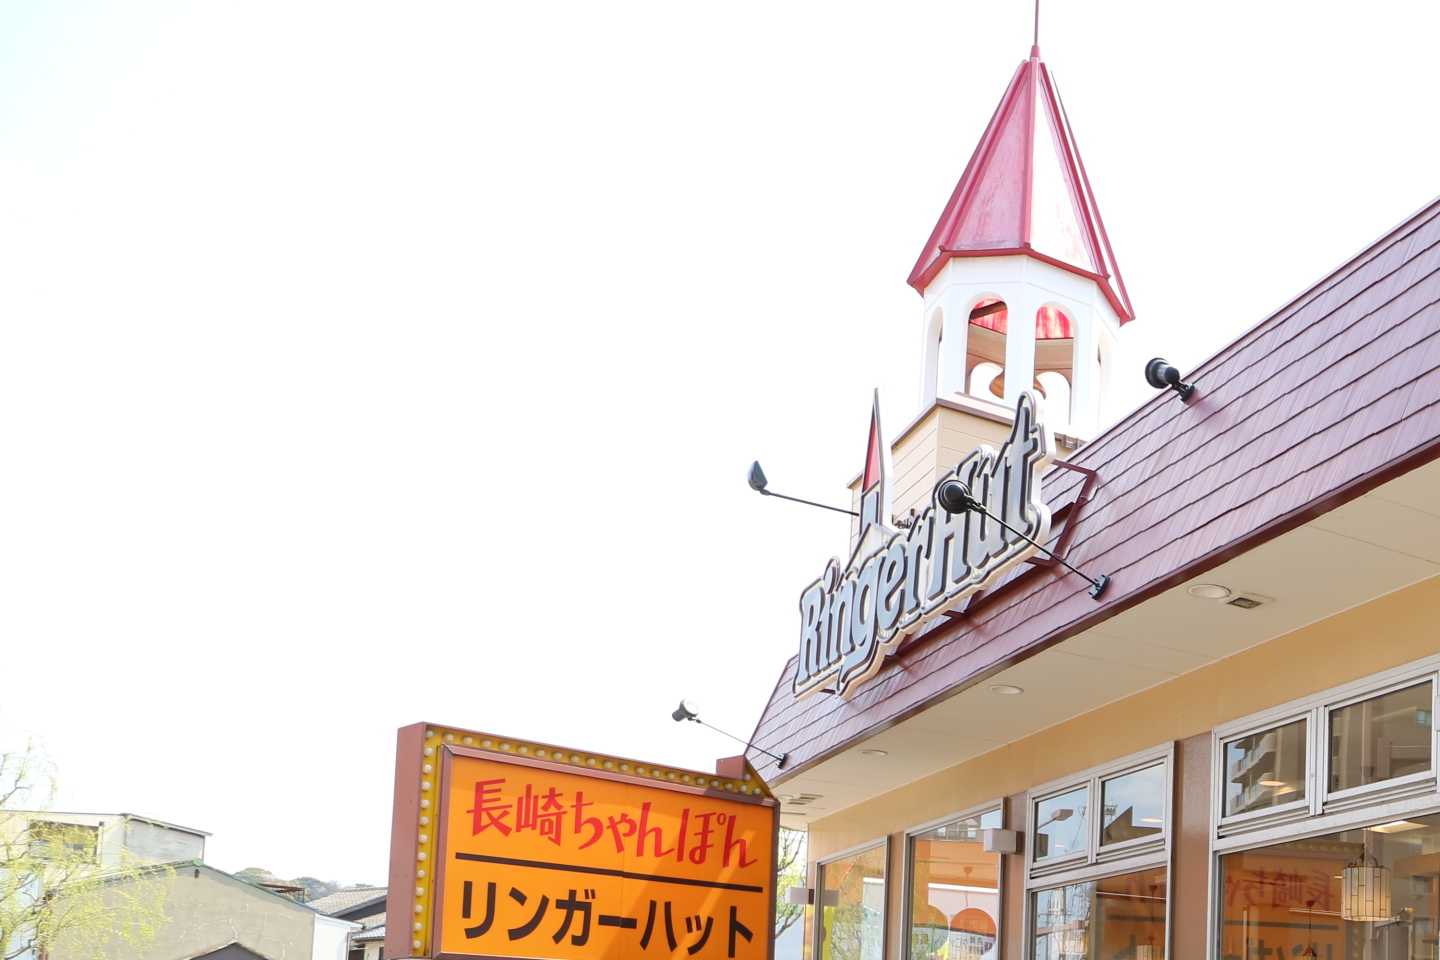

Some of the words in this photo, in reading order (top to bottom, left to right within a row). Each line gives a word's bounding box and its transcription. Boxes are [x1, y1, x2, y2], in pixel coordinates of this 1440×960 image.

[795, 514, 933, 690] Ringer
[928, 402, 1039, 600] Hut
[466, 777, 758, 869] 長崎ちゃんぽん
[461, 879, 755, 959] リンガーハット
